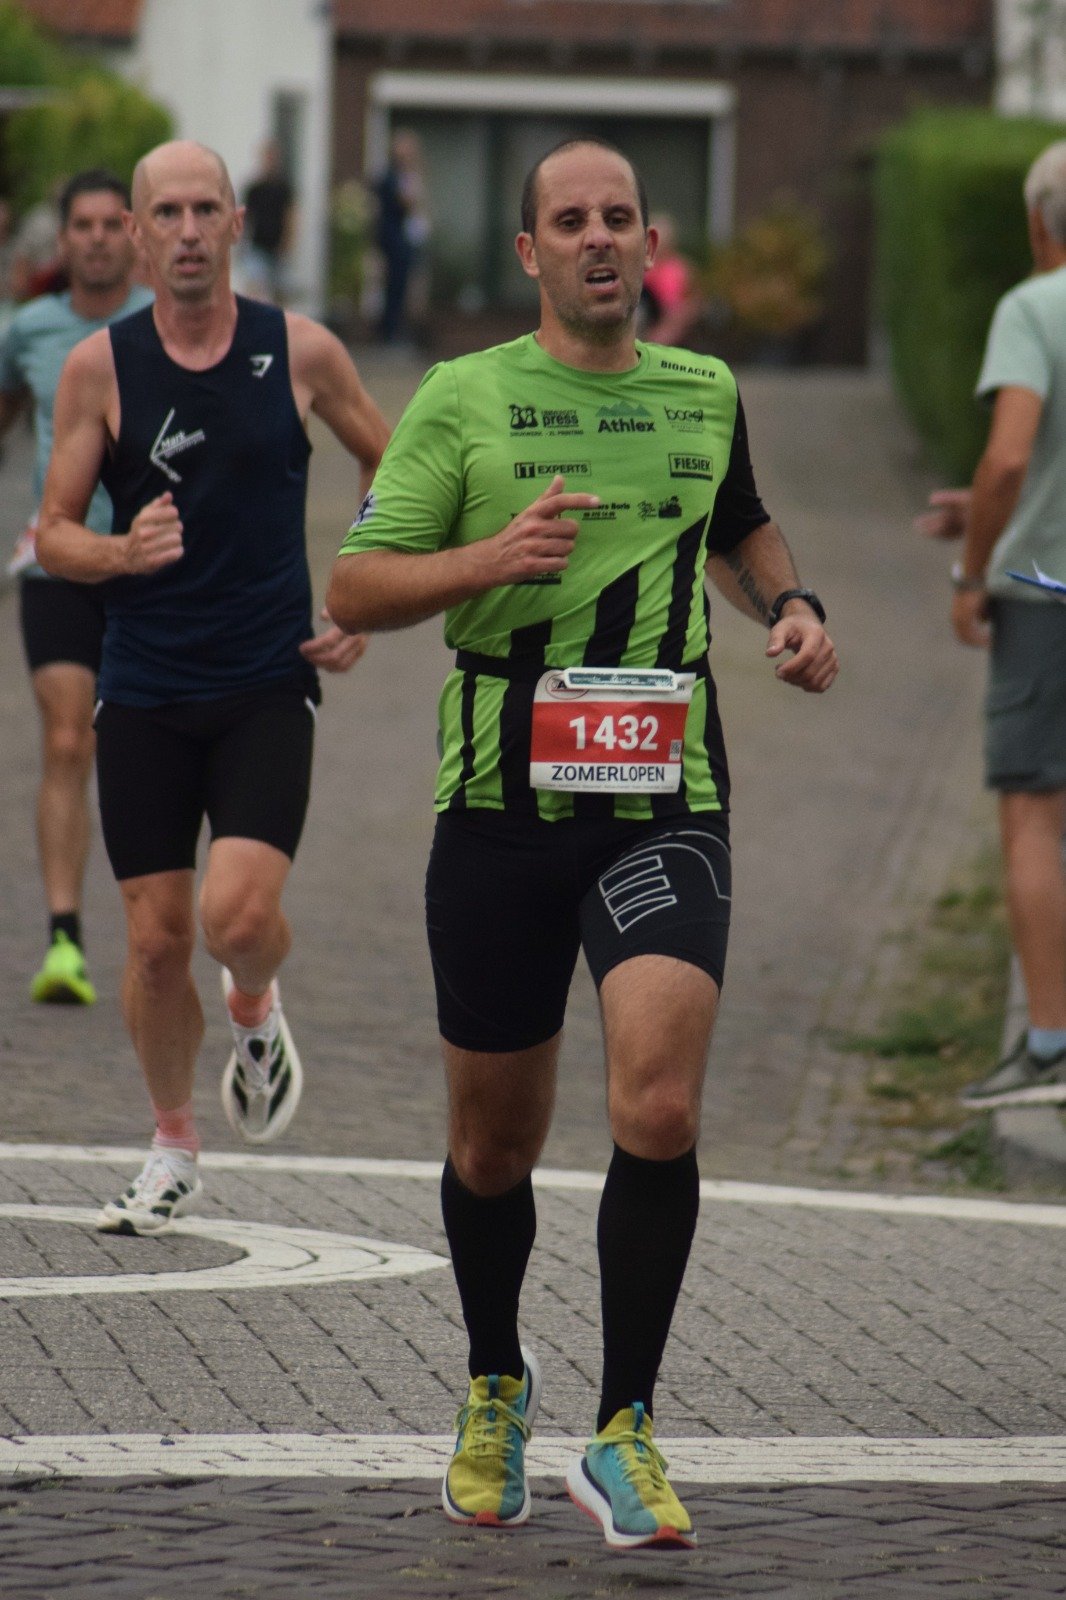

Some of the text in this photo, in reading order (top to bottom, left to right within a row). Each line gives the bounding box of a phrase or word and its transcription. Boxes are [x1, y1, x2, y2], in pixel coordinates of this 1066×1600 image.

[660, 360, 716, 379] BIORACER
[542, 413, 579, 428] press
[598, 418, 656, 433] Athlex
[515, 462, 588, 478] IT EXPERTS
[569, 715, 659, 750] 1432
[551, 765, 665, 782] ZOMERLOPEN
